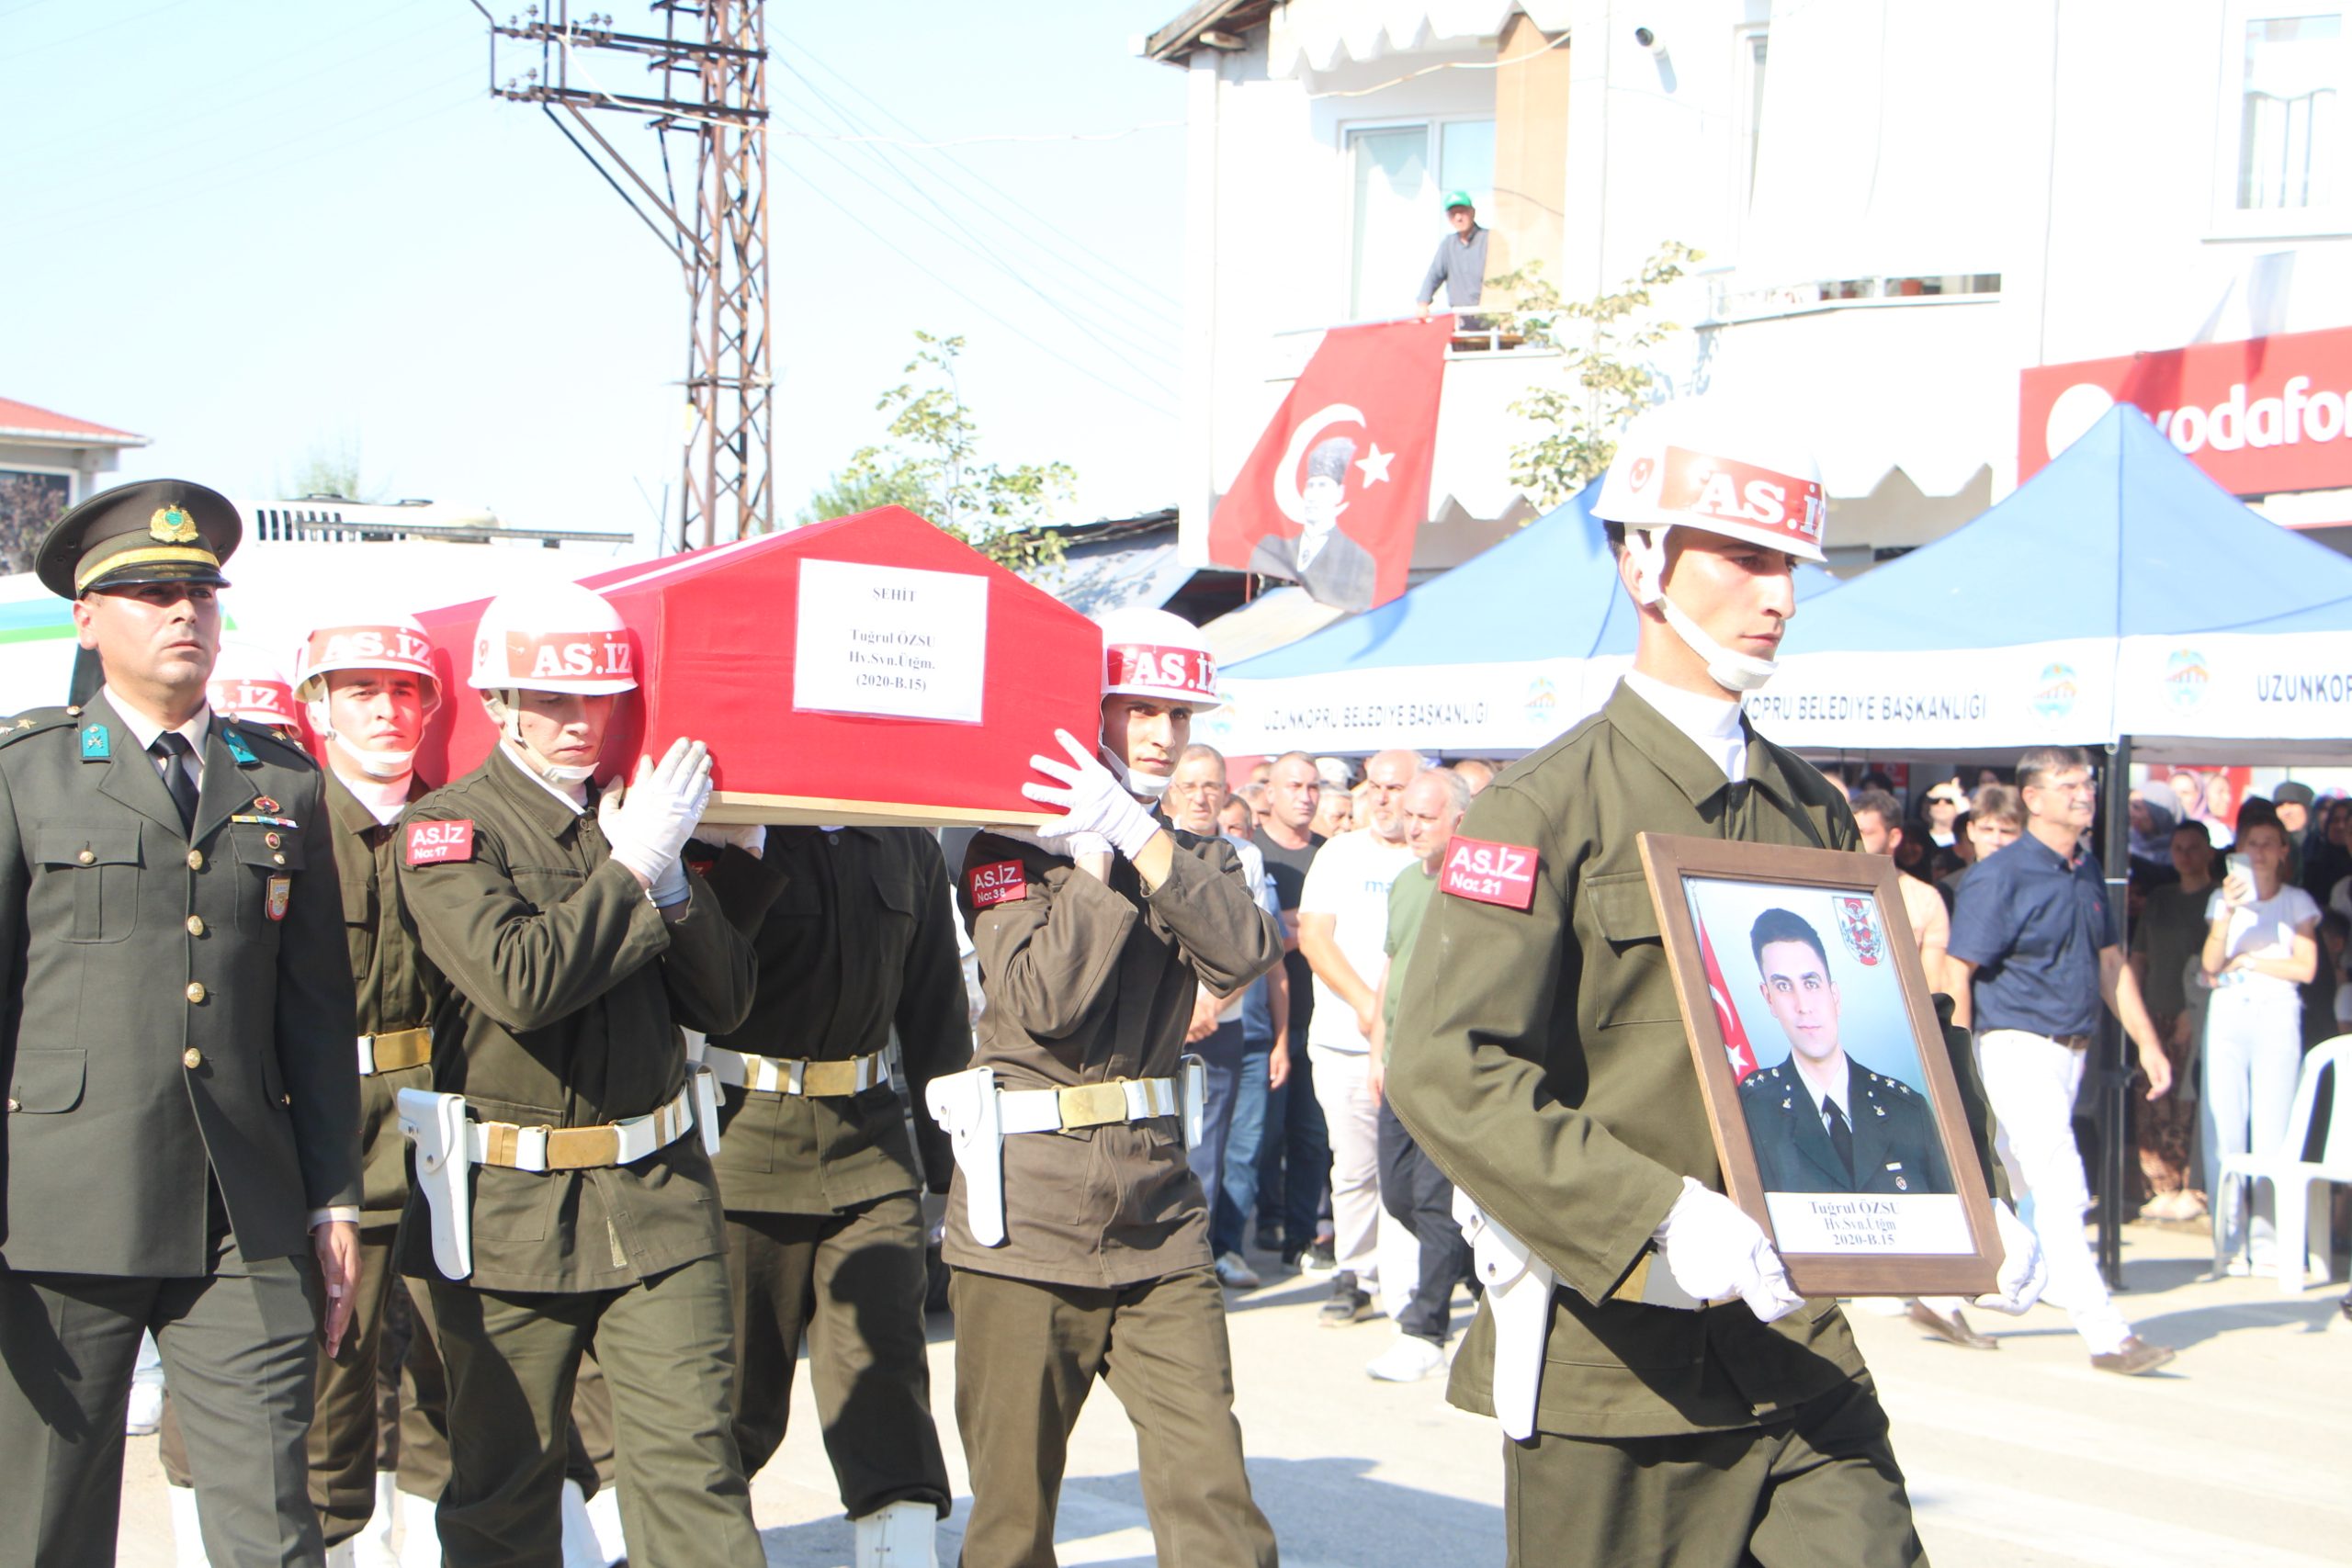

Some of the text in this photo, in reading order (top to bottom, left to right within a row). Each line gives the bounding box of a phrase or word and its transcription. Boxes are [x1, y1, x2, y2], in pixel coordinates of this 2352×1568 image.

[2142, 375, 2352, 454] odafo
[1689, 471, 1823, 536] AS.İ
[849, 628, 894, 645] Tuğrul
[855, 672, 927, 693] (2020-B.15)
[206, 679, 287, 715] S.İZ.
[1808, 1201, 1856, 1216] Tuğrul
[1834, 1234, 1895, 1246] 2020-B.15
